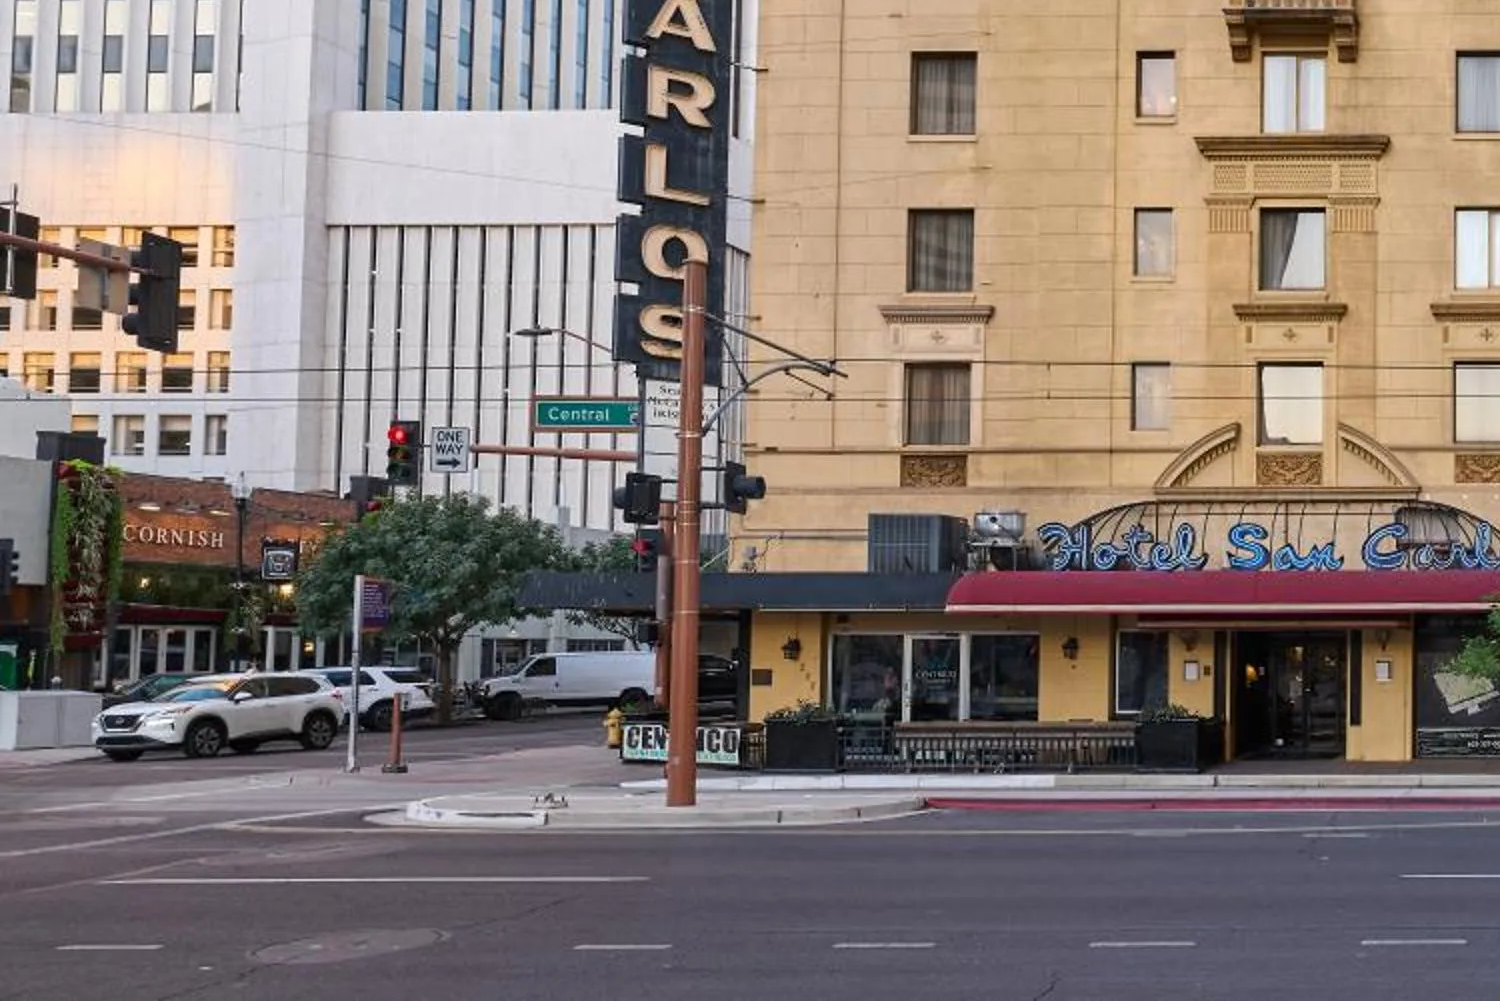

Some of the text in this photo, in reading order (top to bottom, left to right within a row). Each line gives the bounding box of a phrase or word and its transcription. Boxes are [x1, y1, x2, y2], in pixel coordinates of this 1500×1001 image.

[548, 405, 609, 422] Central
[437, 430, 463, 442] ONE
[436, 443, 463, 455] WAY
[123, 525, 224, 548] CORNISH
[1037, 522, 1208, 572] Hotel
[1227, 522, 1344, 572] San
[627, 726, 739, 754] CENICO
